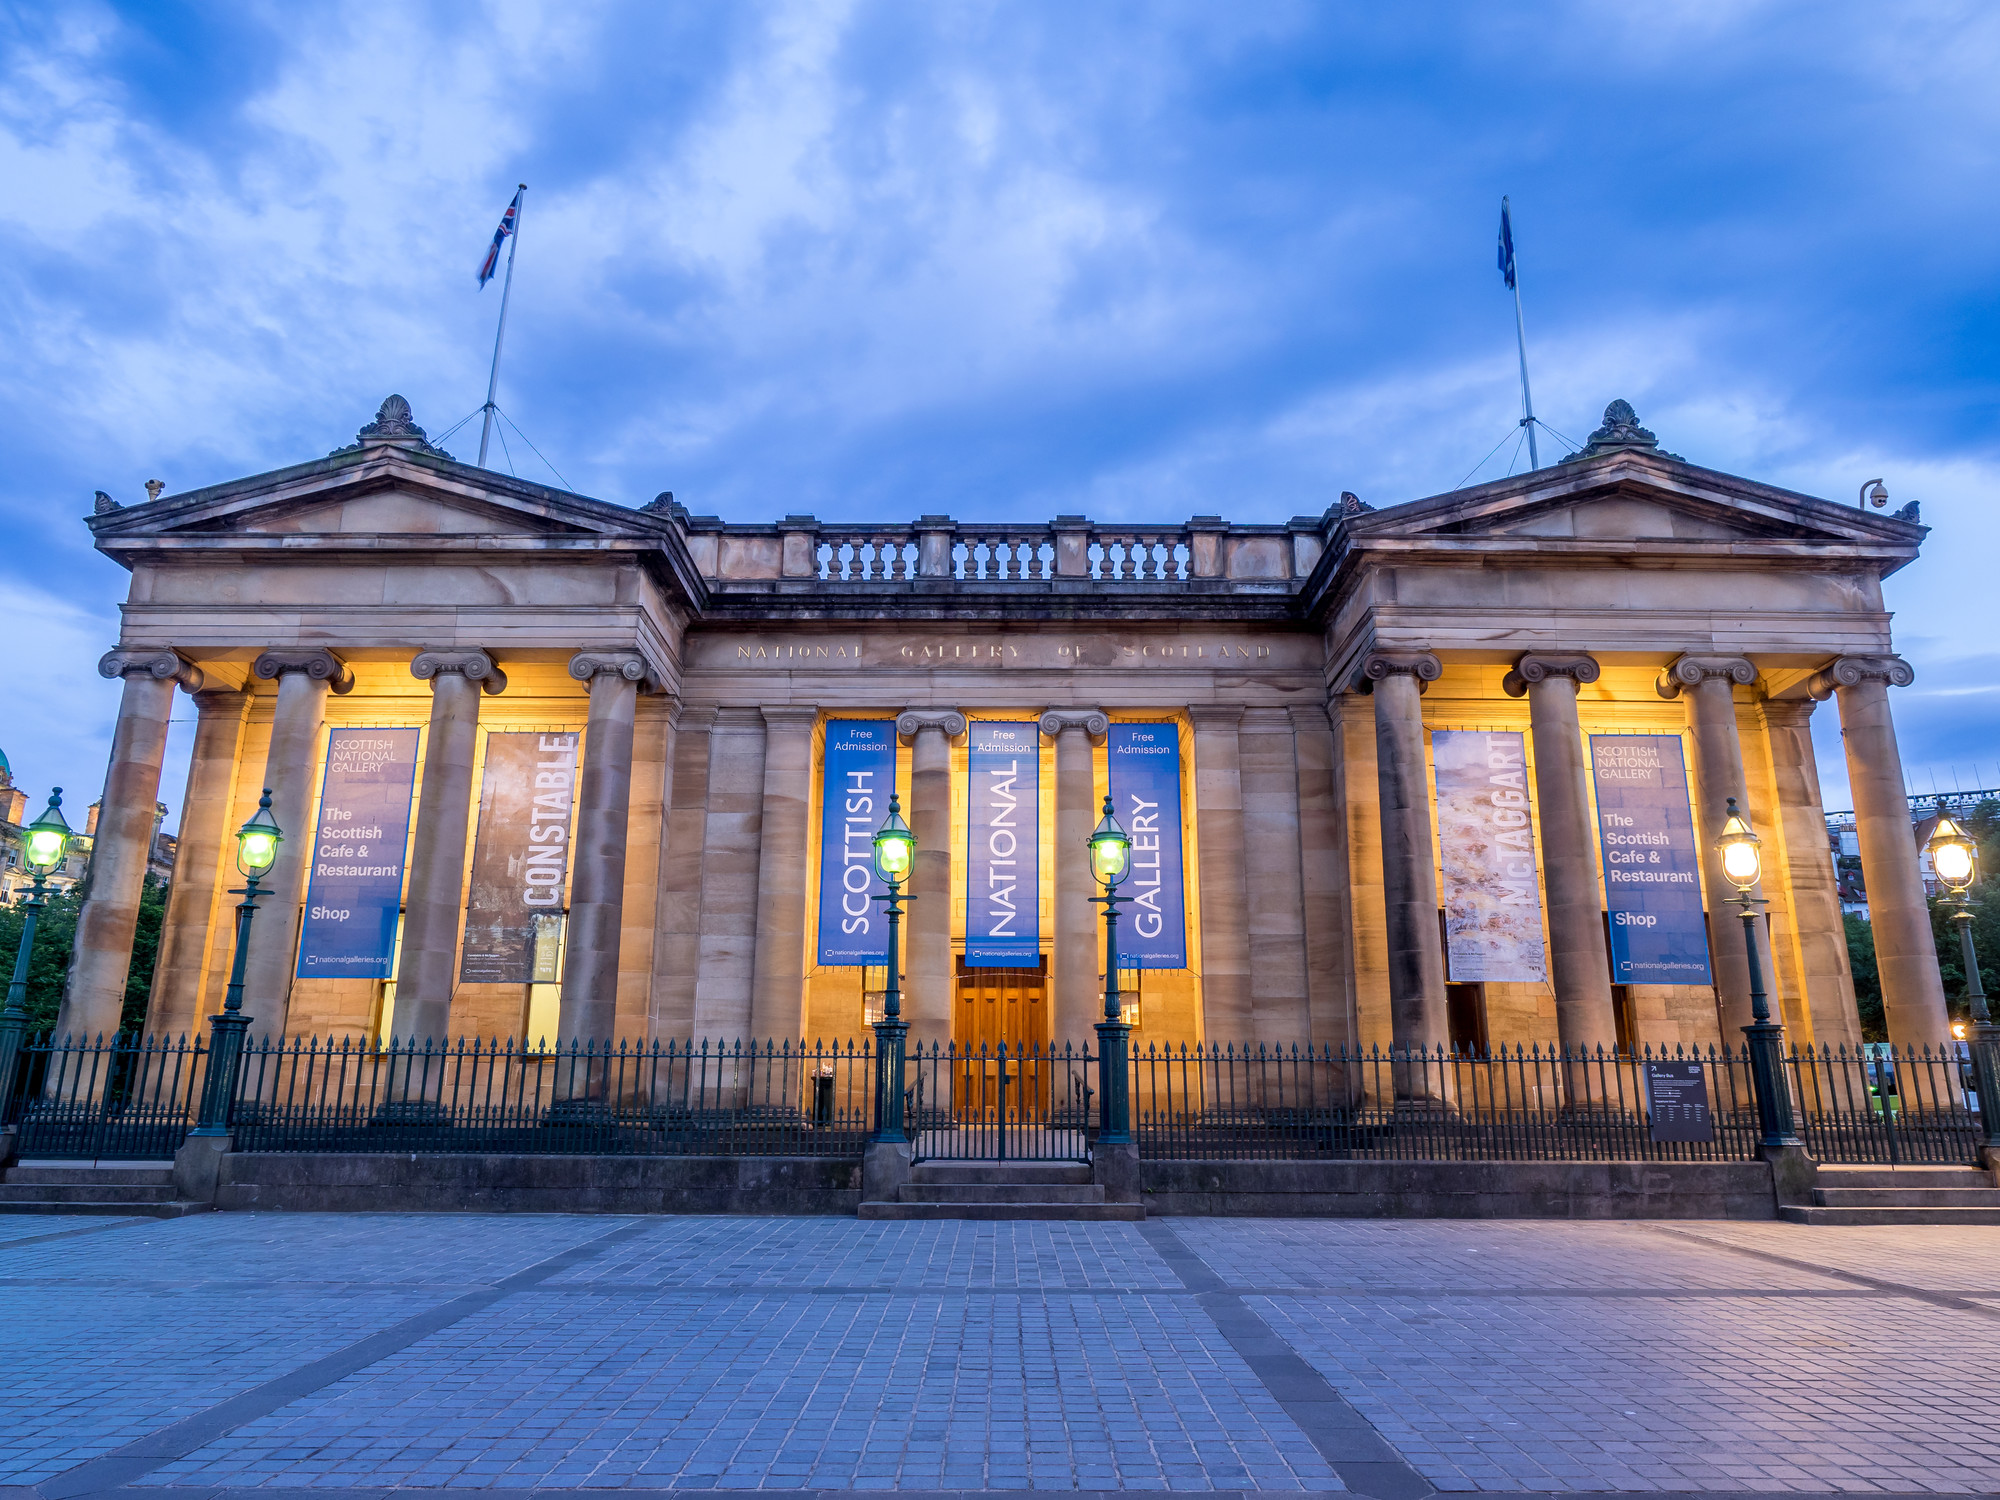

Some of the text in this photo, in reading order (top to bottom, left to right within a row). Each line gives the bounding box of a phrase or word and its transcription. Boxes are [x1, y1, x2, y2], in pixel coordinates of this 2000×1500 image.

[737, 644, 1271, 659] NATIONAL GALLERY OF SCOTLAND
[849, 729, 873, 740] Free
[992, 730, 1016, 740] Free
[1131, 732, 1155, 742] Free
[334, 739, 394, 750] SCOTTISH
[834, 741, 888, 752] Admission
[977, 742, 1031, 753] Admission
[1117, 744, 1170, 755] Admission
[333, 750, 396, 761] NATIONAL
[1596, 746, 1657, 757] SCOTTISH
[331, 762, 385, 773] GALLERY
[1598, 757, 1664, 768] NATIONAL
[1599, 768, 1652, 779] GALLERY
[325, 807, 352, 821] The
[1604, 813, 1634, 826] The
[523, 735, 574, 906] CONSTABLE
[321, 826, 383, 839] Scottish
[1606, 832, 1670, 846] Scottish
[319, 844, 369, 858] Cafe &
[841, 771, 874, 935] SCOTTISH
[988, 760, 1017, 936] NATIONAL
[1608, 850, 1661, 864] Cafe &
[317, 863, 398, 877] Restaurant
[1131, 794, 1163, 938] GALLERY
[1611, 869, 1694, 883] Restaurant
[310, 906, 350, 922] Shop
[1615, 912, 1657, 928] Shop
[834, 949, 885, 957] nationalgalleries.org
[982, 950, 1032, 958] nationalgalleries.org
[1129, 952, 1180, 960] nationalgalleries.org
[318, 954, 389, 965] nationalgalleries.org
[1634, 961, 1705, 972] nationalgalleries.org
